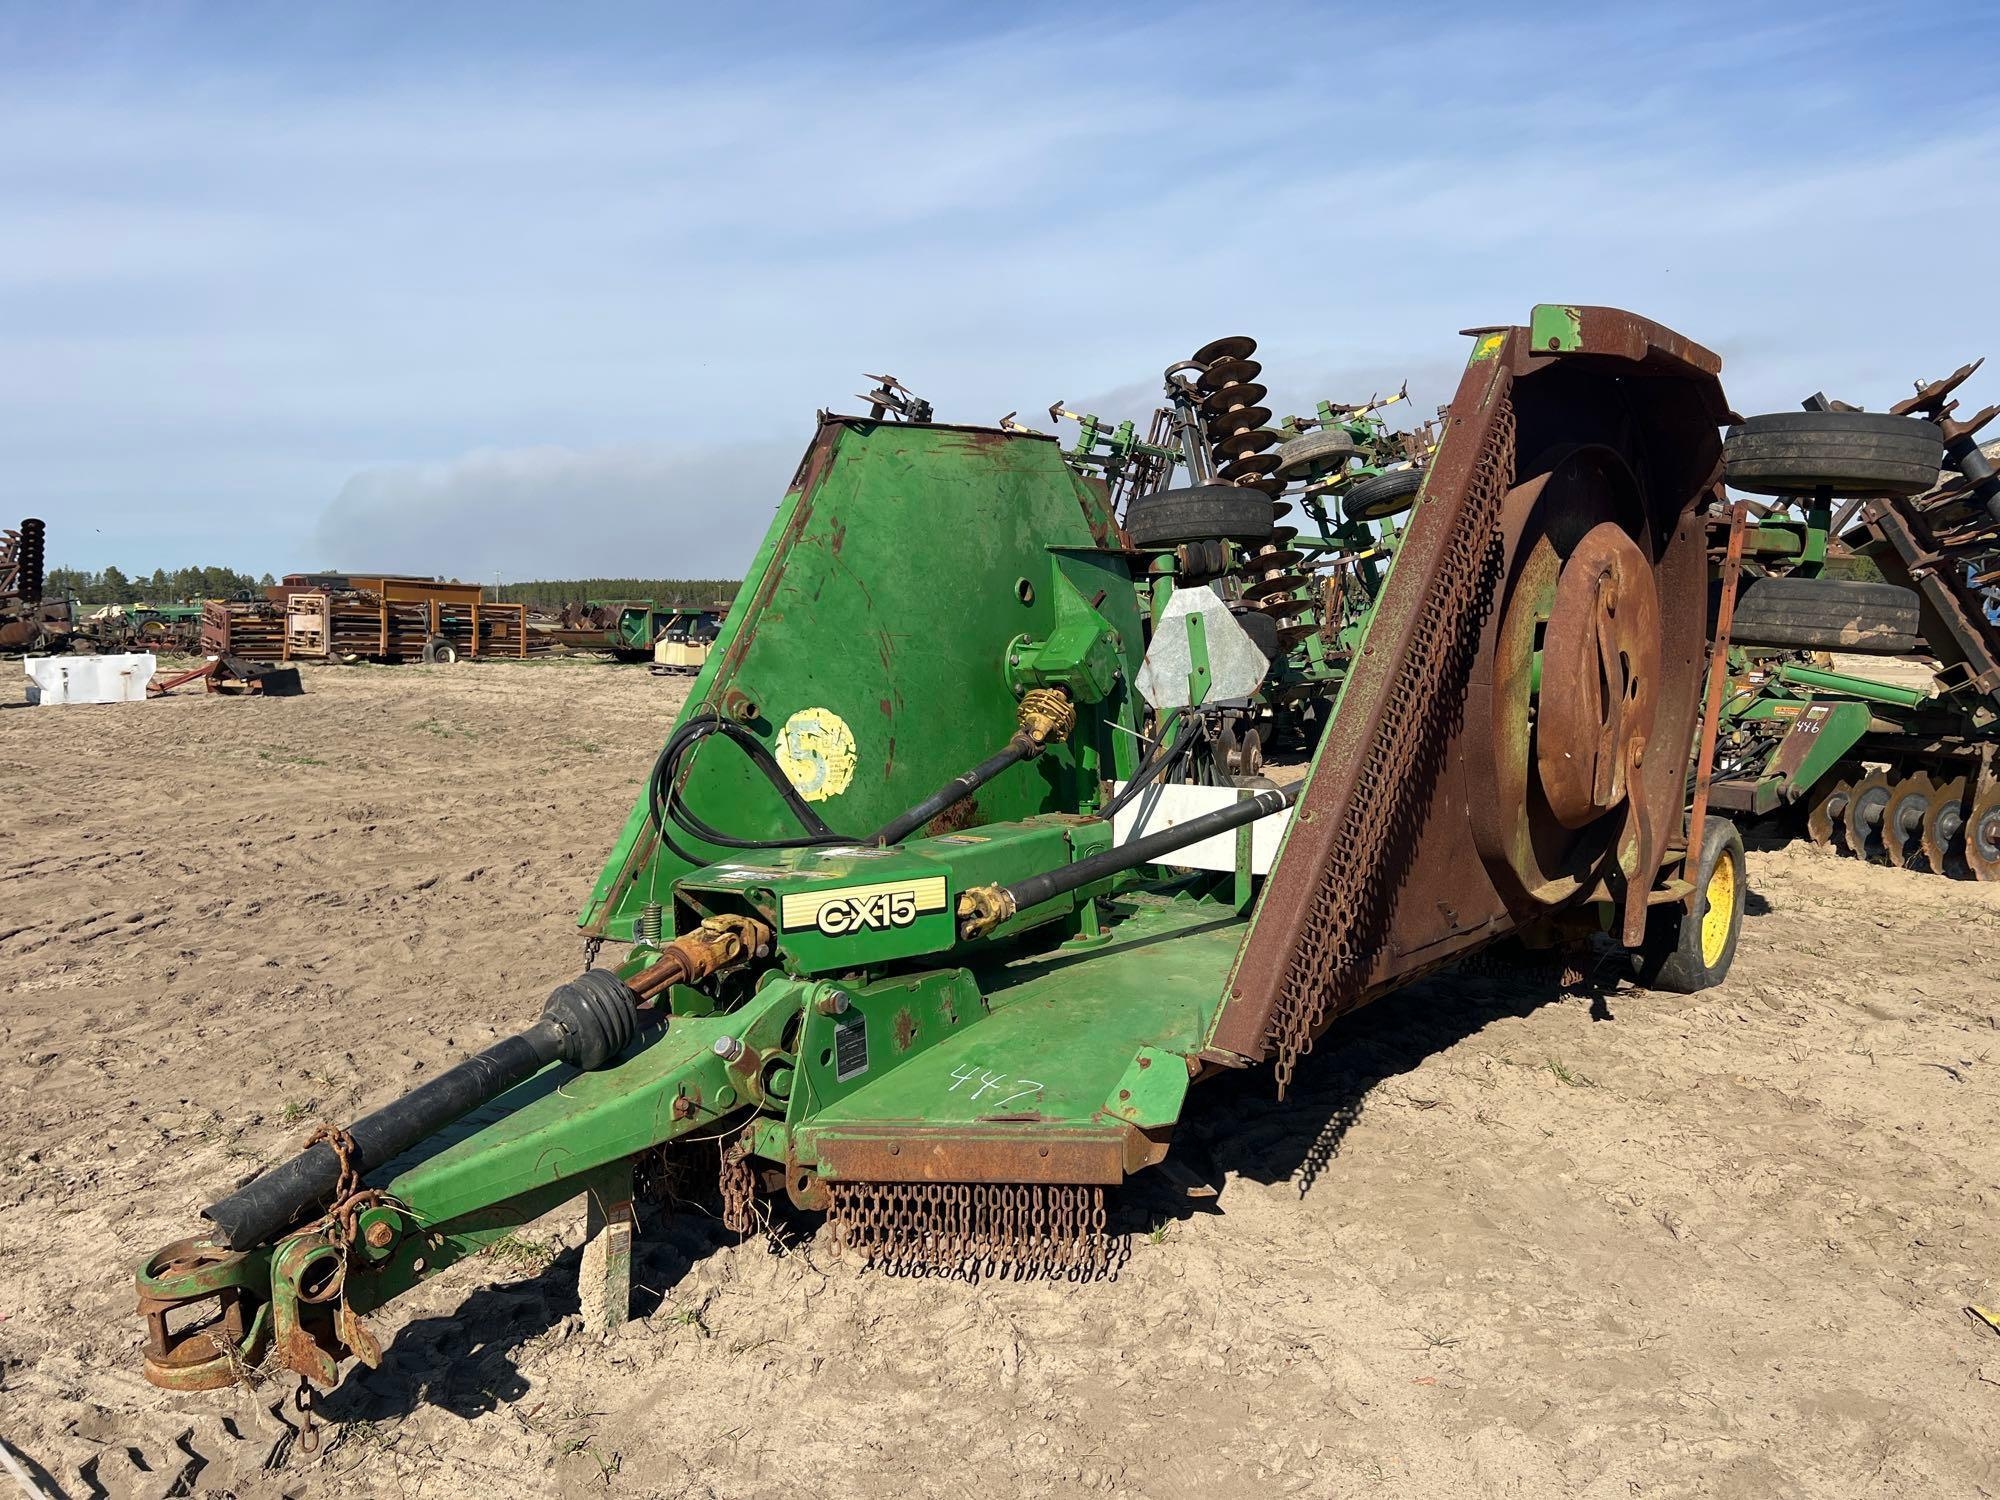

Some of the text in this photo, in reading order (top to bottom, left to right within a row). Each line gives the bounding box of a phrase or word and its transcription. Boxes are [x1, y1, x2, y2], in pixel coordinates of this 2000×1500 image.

[1796, 720, 1820, 734] 446
[788, 719, 827, 794] 5
[816, 891, 917, 937] CX15
[948, 1063, 1045, 1107] 447
